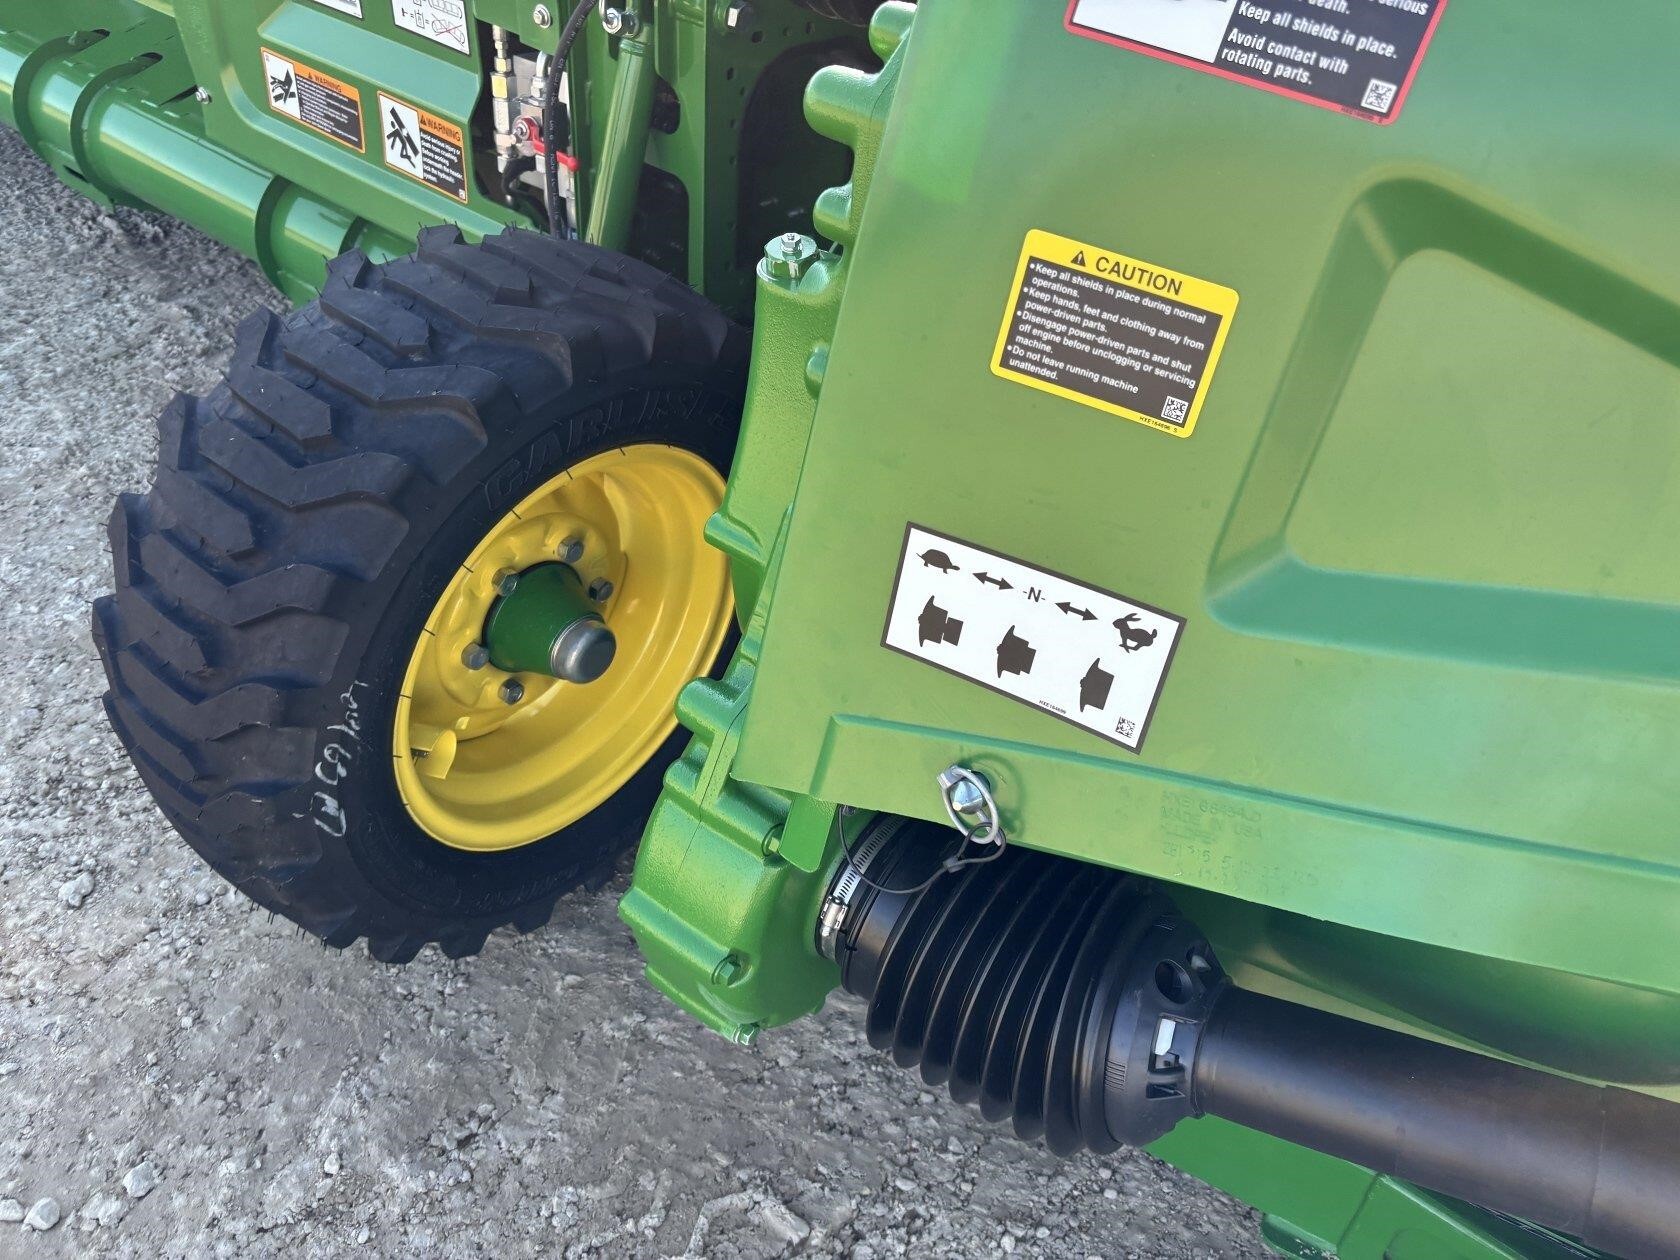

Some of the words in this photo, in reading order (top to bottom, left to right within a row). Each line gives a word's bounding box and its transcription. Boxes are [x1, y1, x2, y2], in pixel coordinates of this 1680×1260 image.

[1227, 28, 1266, 51] Avoid
[1267, 41, 1317, 66] contact
[1318, 56, 1349, 75] with
[1238, 1, 1271, 24] Keep
[1272, 13, 1292, 28] all
[1292, 18, 1340, 42] shields
[1341, 30, 1356, 46] in
[1356, 36, 1397, 59] place.
[1221, 48, 1273, 75] rotating
[1273, 63, 1312, 85] parts.
[427, 120, 460, 142] WARNING
[1031, 277, 1080, 298] operations.
[1035, 263, 1058, 279] Keep
[1059, 272, 1071, 282] all
[1072, 276, 1103, 292] shields
[1105, 285, 1115, 295] in
[1115, 290, 1140, 303] place
[1142, 297, 1172, 315] during
[1173, 308, 1207, 325] normal
[1096, 257, 1183, 296] CAUTION
[1025, 301, 1081, 324] power-driven
[1082, 318, 1108, 332] parts.
[1028, 287, 1051, 302] Keep
[1052, 295, 1081, 312] hands,
[1083, 305, 1100, 317] feet
[1101, 311, 1120, 323] and
[1120, 317, 1157, 337] clothing
[1157, 329, 1182, 345] away
[1182, 336, 1205, 351] from
[1015, 335, 1054, 354] machine.
[1019, 323, 1032, 333] off
[1032, 328, 1062, 343] engine
[1062, 336, 1091, 353] before
[1092, 347, 1142, 371] unclogging
[1142, 363, 1154, 373] or
[1154, 367, 1197, 389] servicing
[1022, 311, 1068, 333] Disengage
[1068, 326, 1126, 351] power-driven
[1126, 345, 1151, 359] parts
[1151, 353, 1170, 366] and
[1170, 360, 1192, 373] shut
[1009, 358, 1059, 380] unattended.
[1012, 345, 1025, 357] Do
[1026, 351, 1041, 362] not
[1041, 356, 1065, 370] leave
[1065, 364, 1101, 383] running
[1101, 375, 1140, 394] machine
